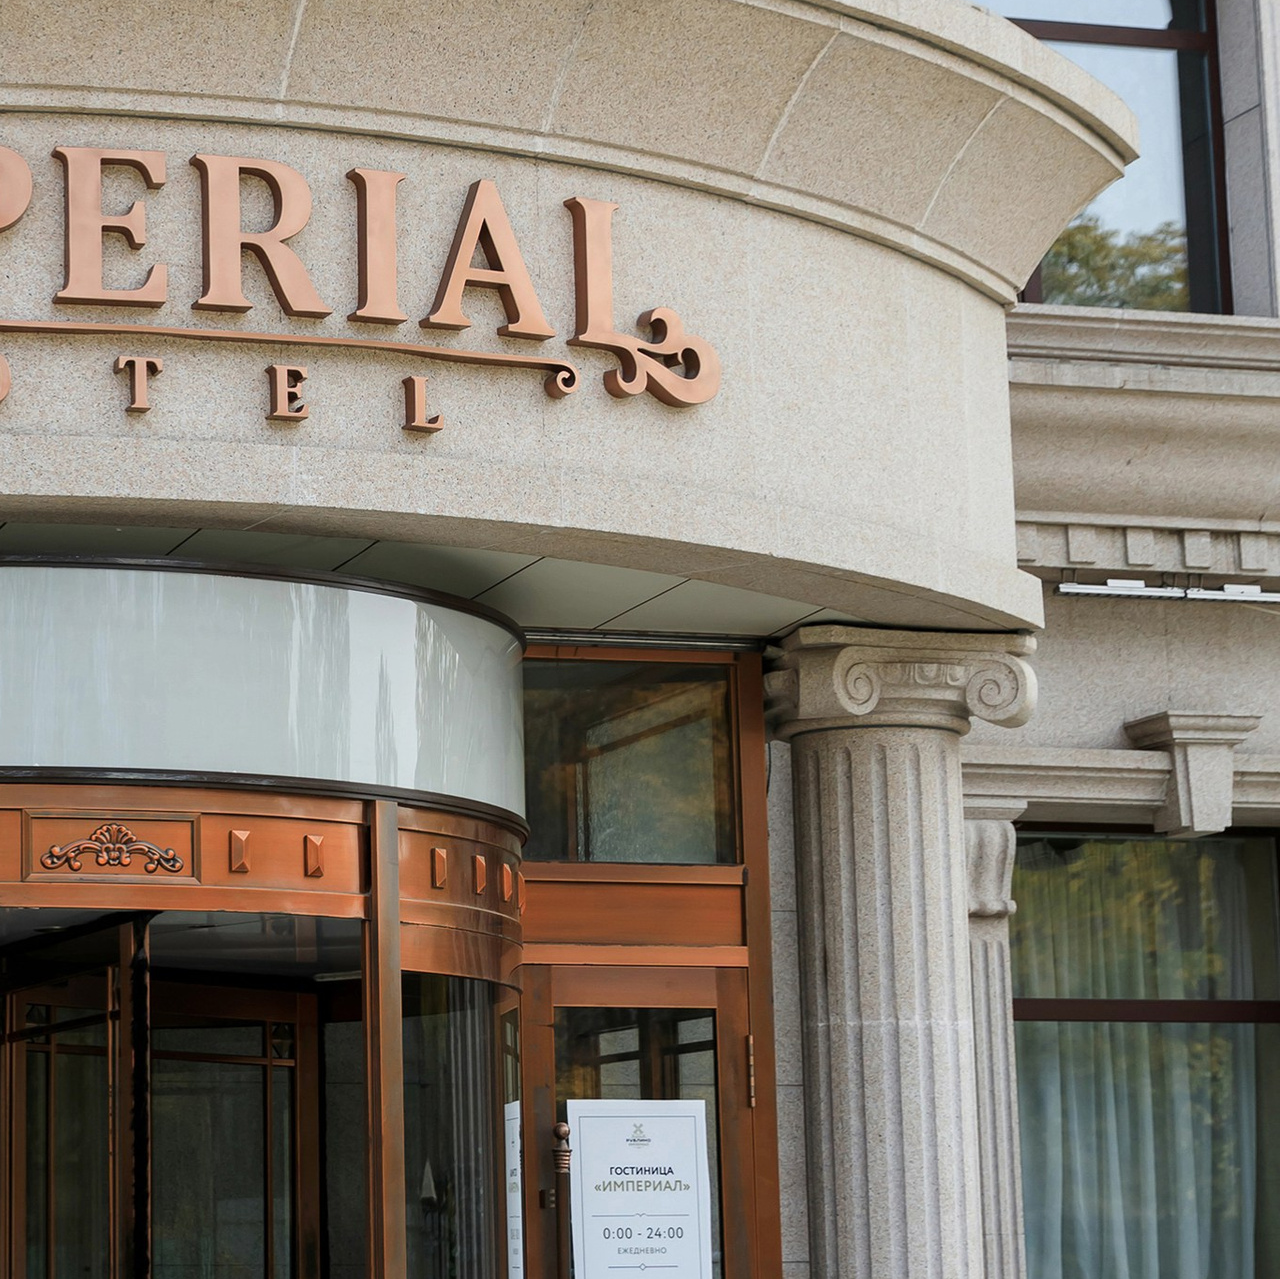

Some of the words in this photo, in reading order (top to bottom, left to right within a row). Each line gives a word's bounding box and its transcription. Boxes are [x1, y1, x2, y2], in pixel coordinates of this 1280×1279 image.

[609, 1166, 674, 1176] ГОСТИНИЦА
[594, 1180, 691, 1192] «ИМПЕРИАЛ»
[603, 1227, 633, 1240] 0:00
[646, 1226, 684, 1239] 24:00
[617, 1246, 667, 1255] ЕЖЕДНЕВНО
